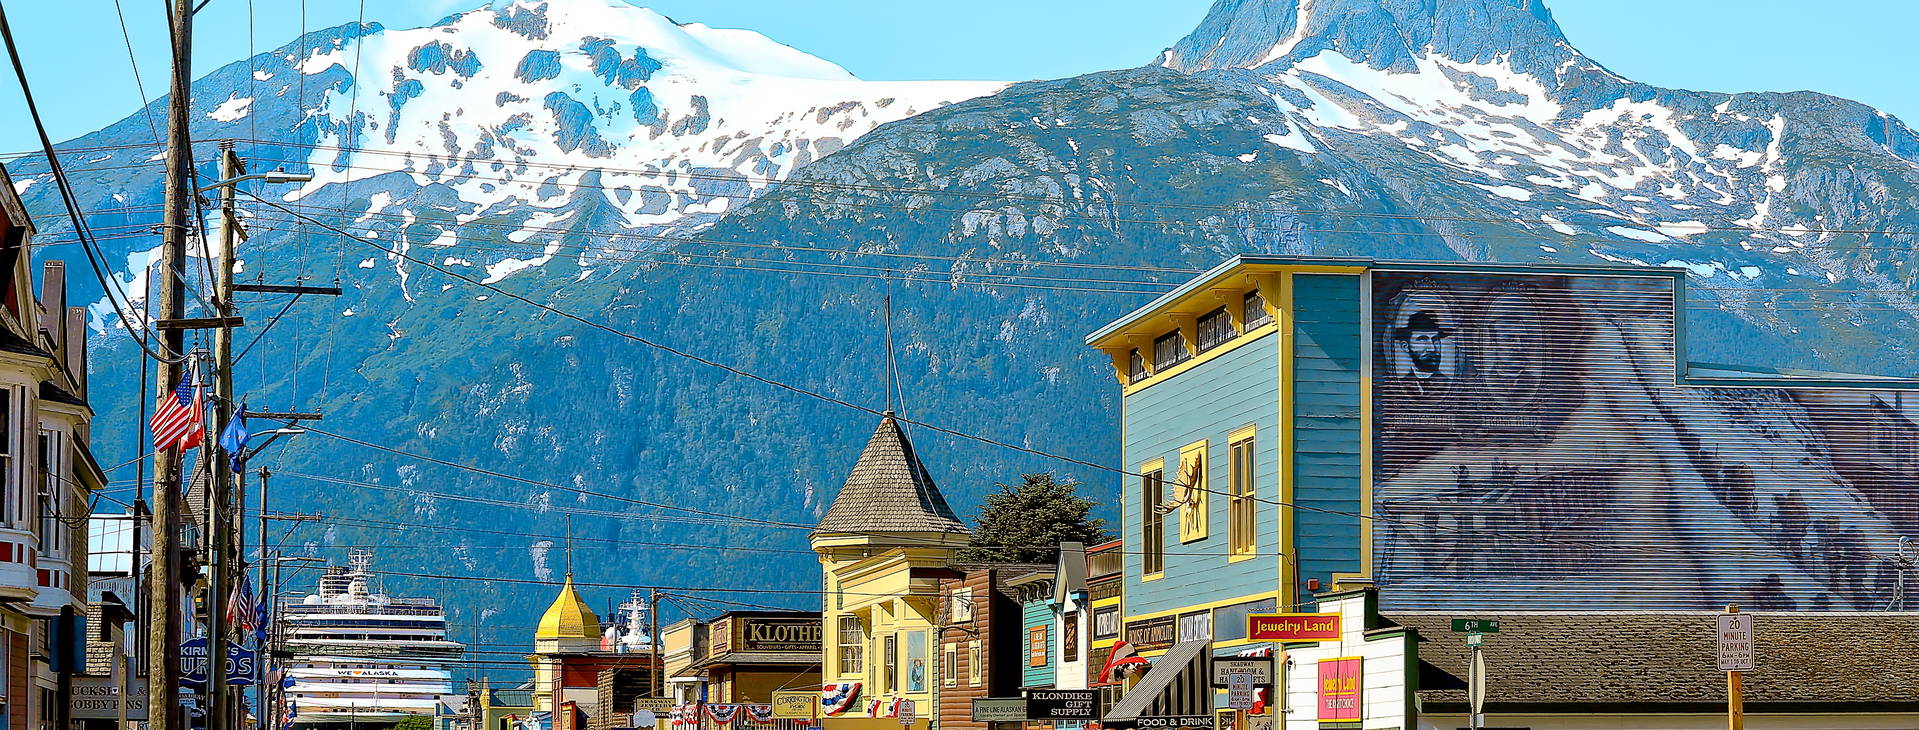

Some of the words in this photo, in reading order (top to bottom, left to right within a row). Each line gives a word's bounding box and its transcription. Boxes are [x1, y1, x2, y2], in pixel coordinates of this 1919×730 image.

[1255, 619, 1300, 635] Jewelry
[1304, 619, 1334, 631] Land
[1464, 621, 1479, 630] 6TH
[1729, 620, 1740, 629] 20
[1129, 629, 1143, 643] HOUSE
[1144, 628, 1151, 642] OF
[1723, 632, 1746, 640] MINUTE
[1721, 643, 1749, 651] PARKING
[180, 657, 252, 675] UROS
[137, 687, 146, 696] &
[1032, 692, 1093, 700] KLONDIKE
[72, 699, 109, 710] OBBY
[112, 699, 143, 710] PNS
[1050, 708, 1092, 716] SUPPLY
[1137, 718, 1167, 726] FOOD
[1169, 718, 1178, 726] &
[1180, 717, 1213, 726] DRINK
